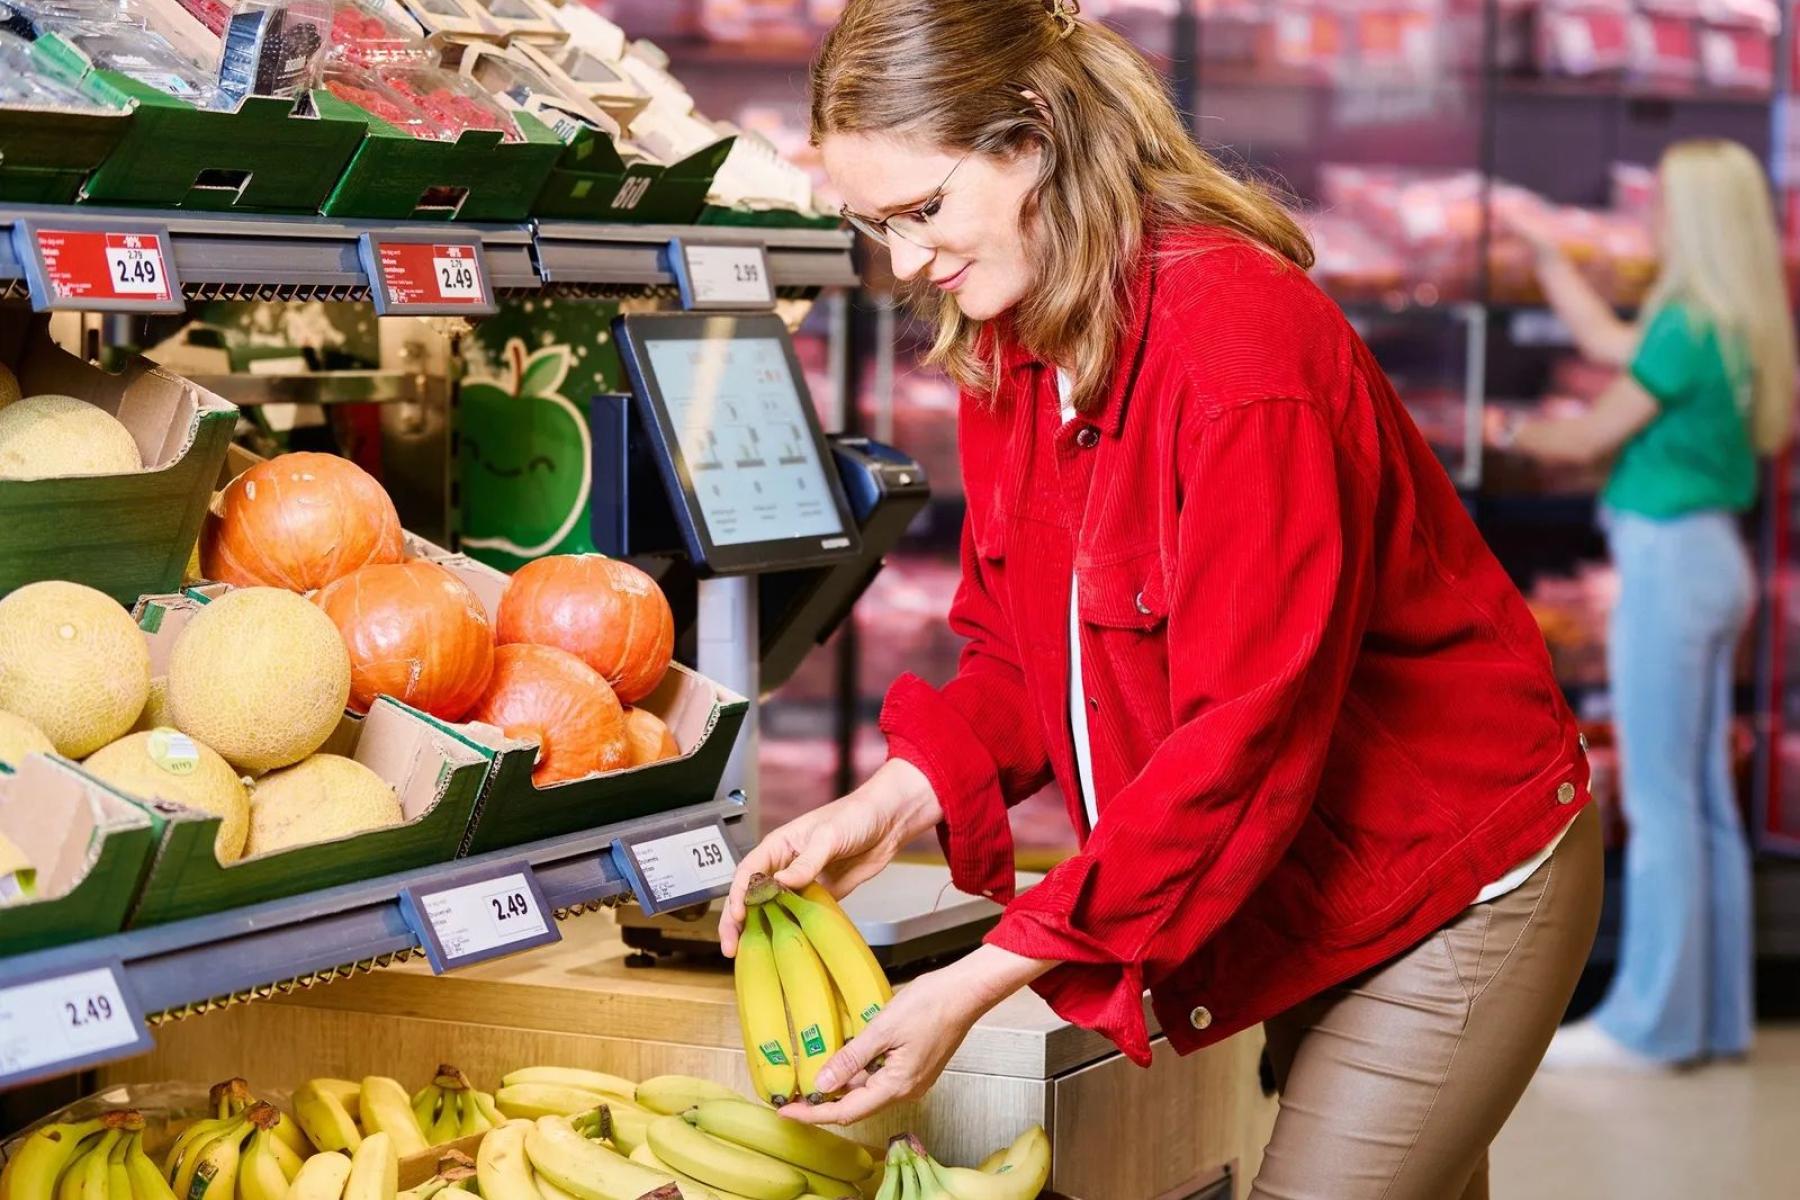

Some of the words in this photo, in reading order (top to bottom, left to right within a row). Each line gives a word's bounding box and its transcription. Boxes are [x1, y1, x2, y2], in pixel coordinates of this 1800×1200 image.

[127, 250, 143, 260] 2.79
[117, 259, 156, 283] 2.49
[442, 268, 473, 289] 2.49
[734, 264, 758, 282] 2.99
[692, 843, 723, 868] 2.59
[492, 893, 528, 921] 2.49
[65, 995, 112, 1026] 2.49
